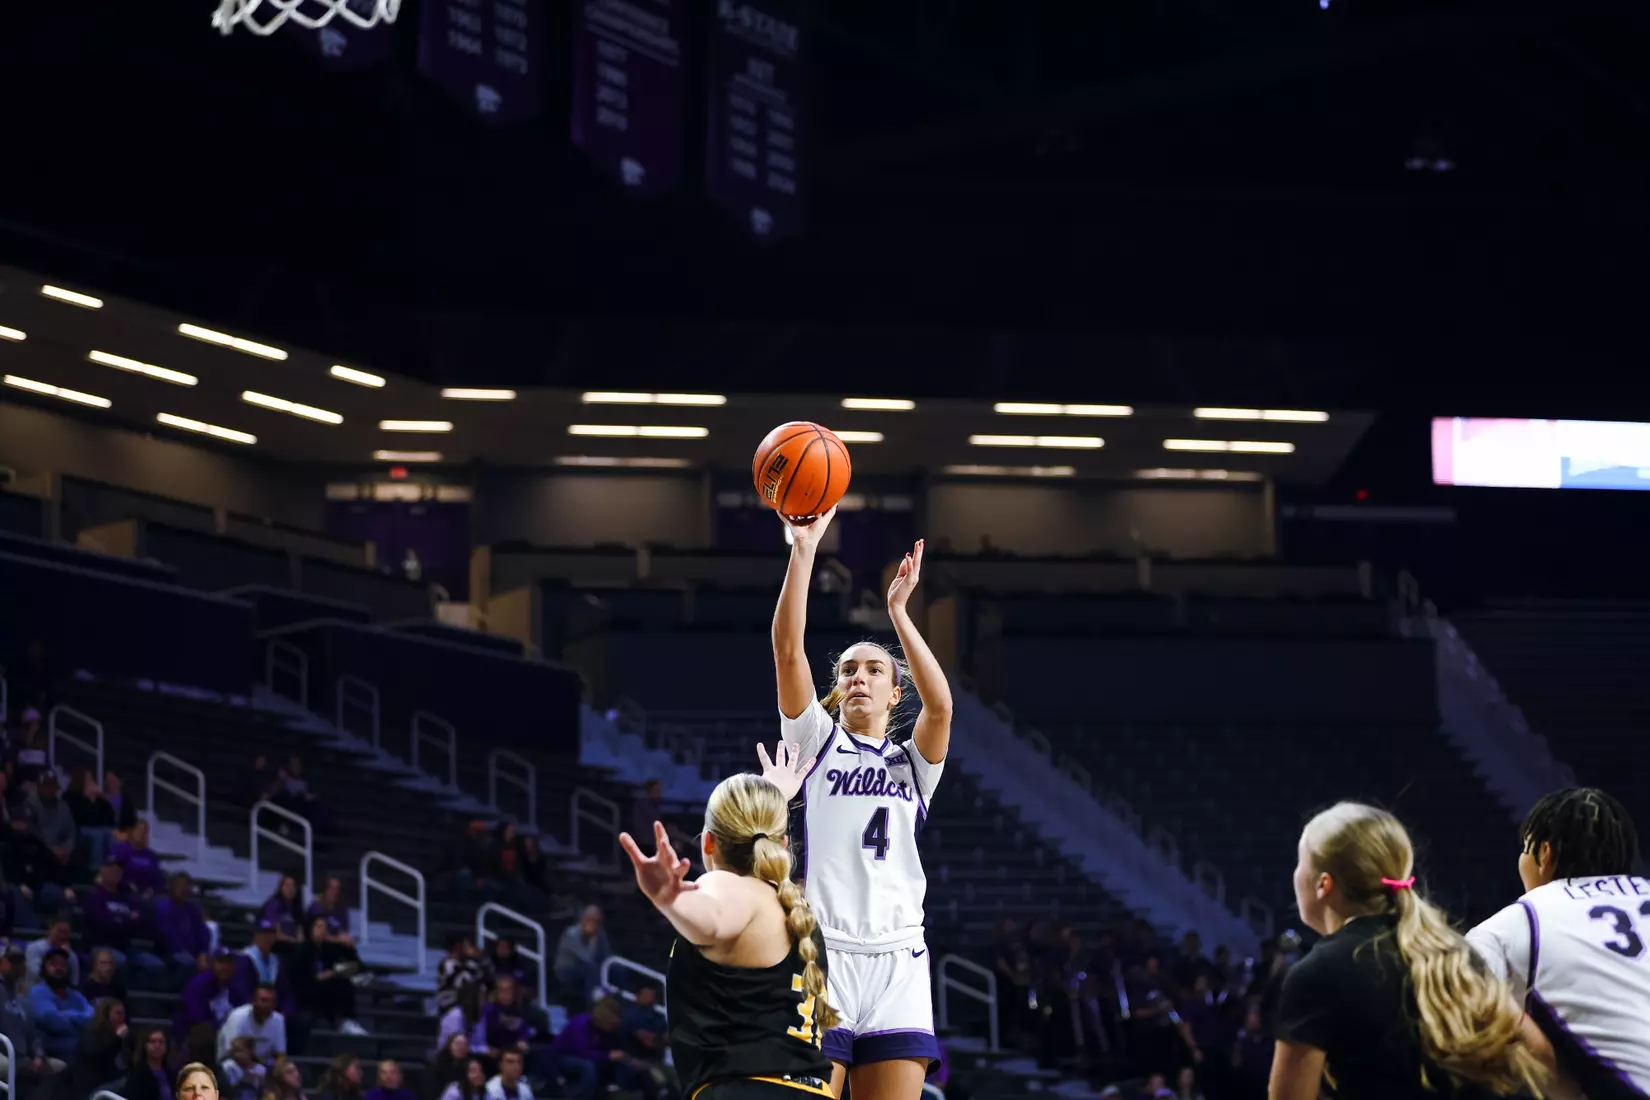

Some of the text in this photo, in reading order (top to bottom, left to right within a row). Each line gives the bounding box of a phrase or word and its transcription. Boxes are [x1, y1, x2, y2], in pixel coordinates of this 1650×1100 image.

[762, 453, 789, 502] ELITE
[861, 806, 890, 861] 4
[1587, 899, 1650, 959] 3
